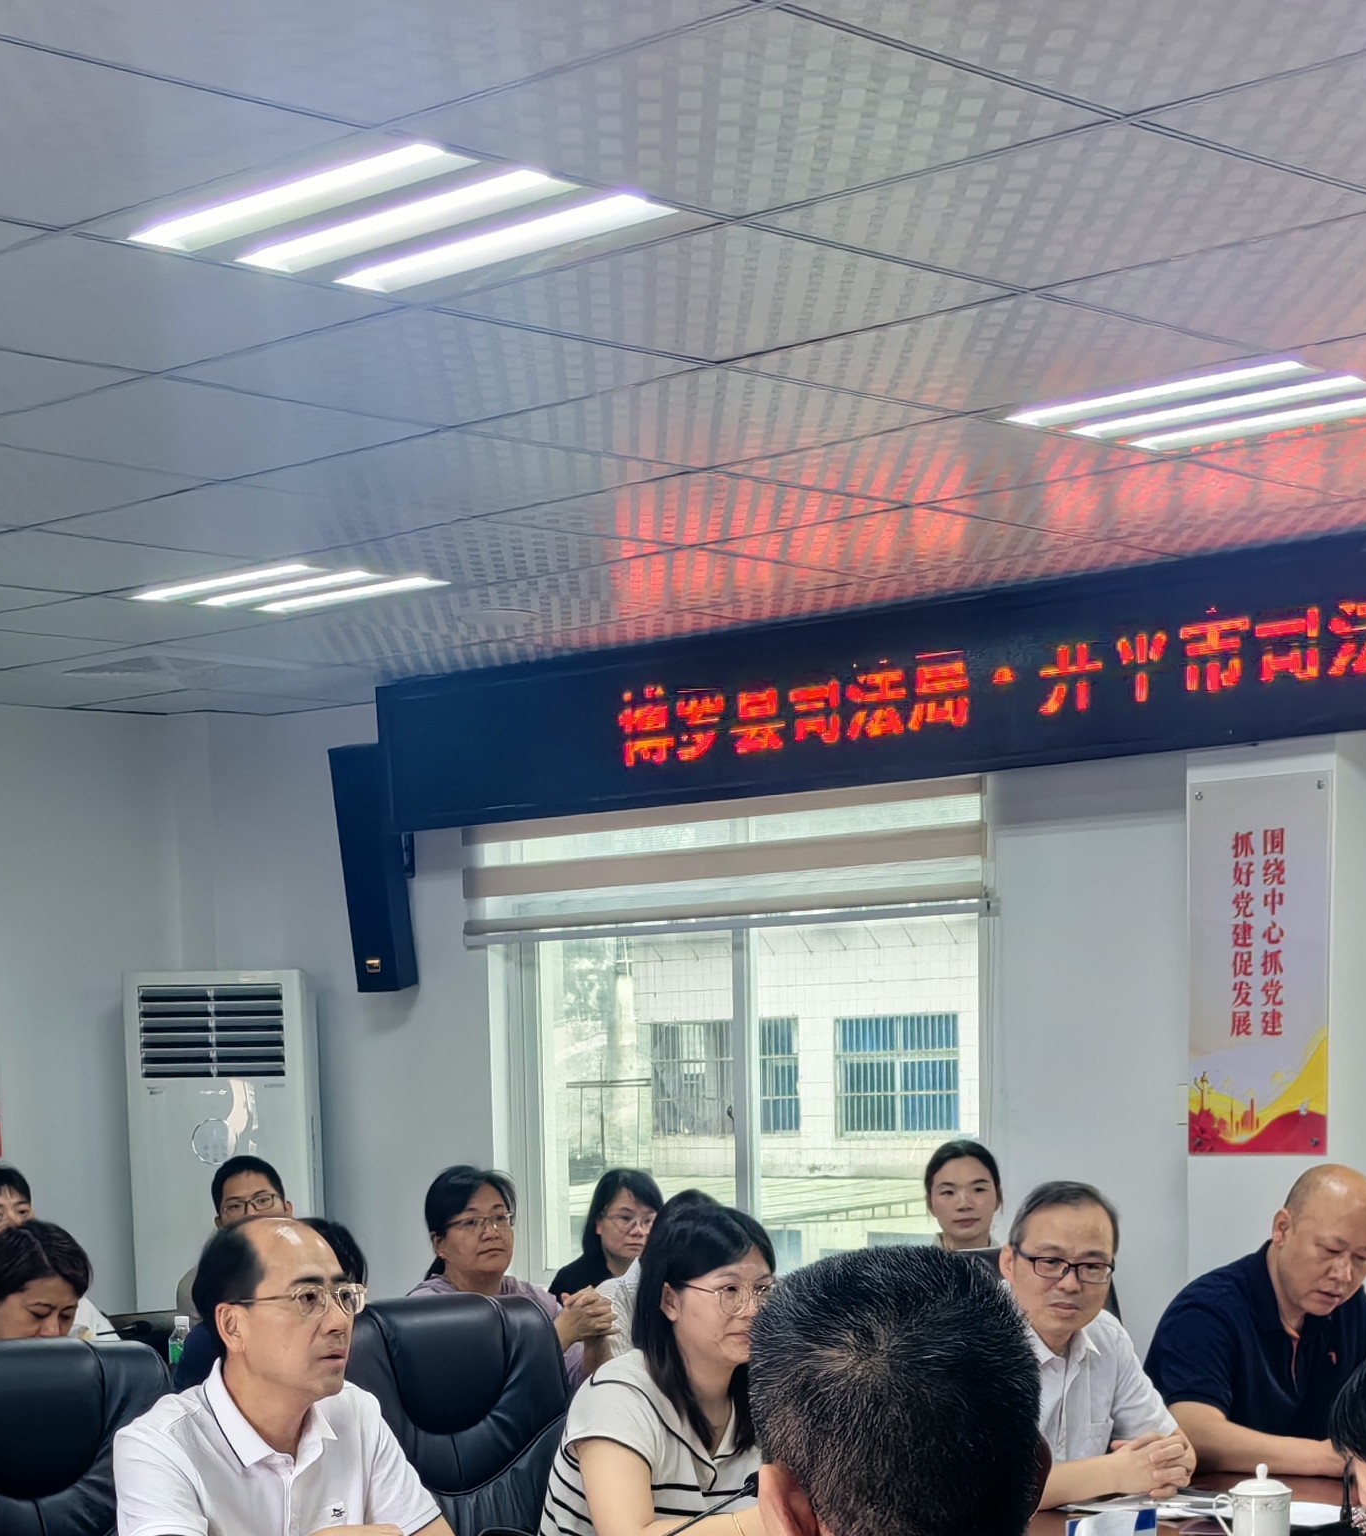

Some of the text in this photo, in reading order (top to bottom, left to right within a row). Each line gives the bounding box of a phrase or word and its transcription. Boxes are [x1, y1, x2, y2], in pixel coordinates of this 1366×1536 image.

[1230, 830, 1255, 1038] 抓好党建促发展
[1260, 827, 1286, 1037] 围绕中心抓党建
